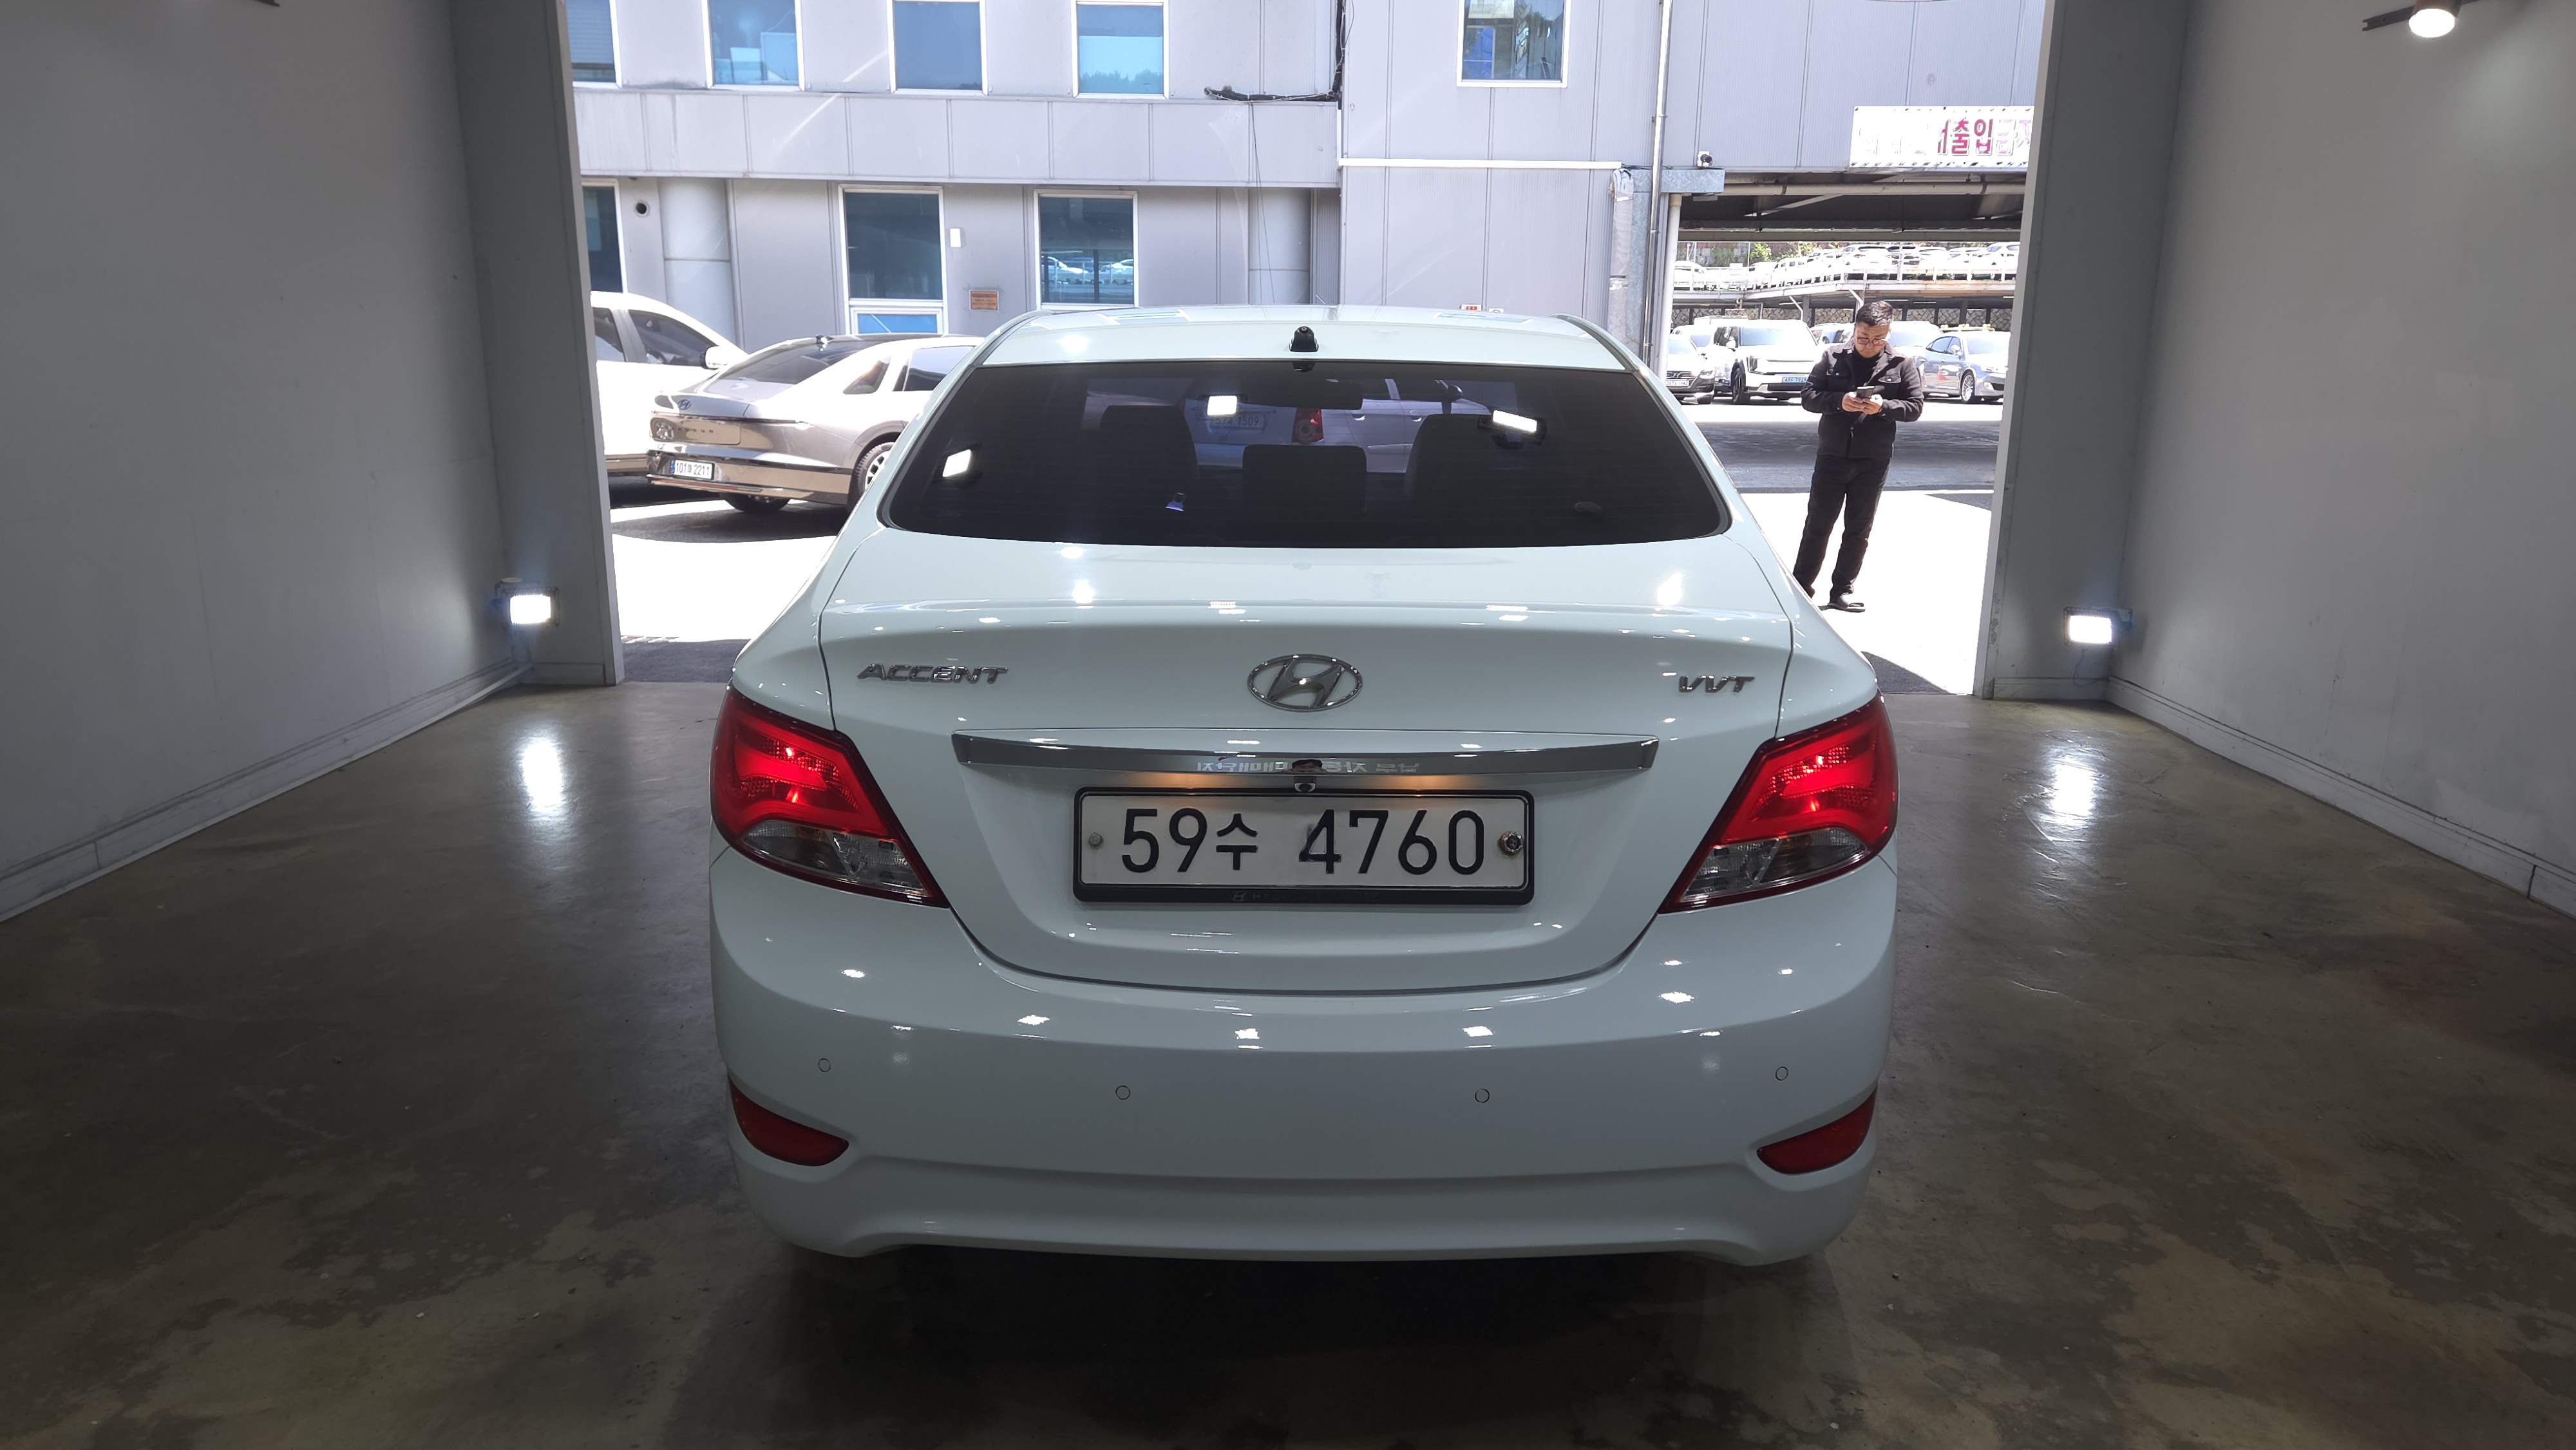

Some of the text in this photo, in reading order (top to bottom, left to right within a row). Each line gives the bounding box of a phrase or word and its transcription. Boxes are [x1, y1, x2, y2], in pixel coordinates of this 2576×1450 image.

[1237, 417, 1259, 426] 1509
[694, 464, 710, 476] 2211
[857, 663, 1009, 684] ACCENT
[1679, 675, 1756, 693] VVT
[1121, 807, 1485, 876] 59수 4760
